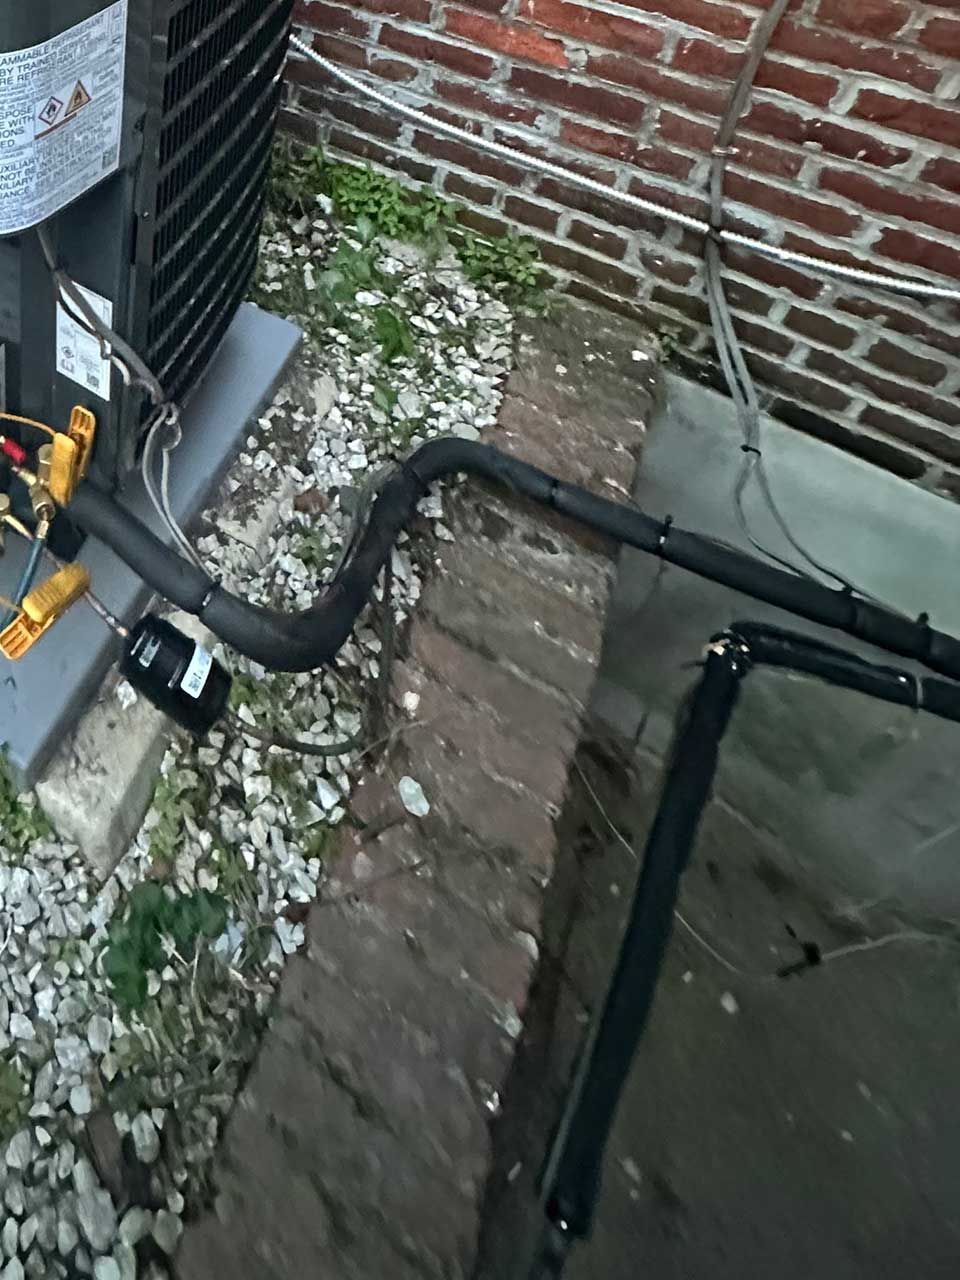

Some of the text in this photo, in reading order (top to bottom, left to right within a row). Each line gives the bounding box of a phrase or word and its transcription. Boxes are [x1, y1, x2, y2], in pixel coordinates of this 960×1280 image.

[0, 66, 14, 77] BY
[17, 51, 57, 73] TRAINED
[8, 111, 34, 127] WITH
[0, 171, 23, 183] NOT
